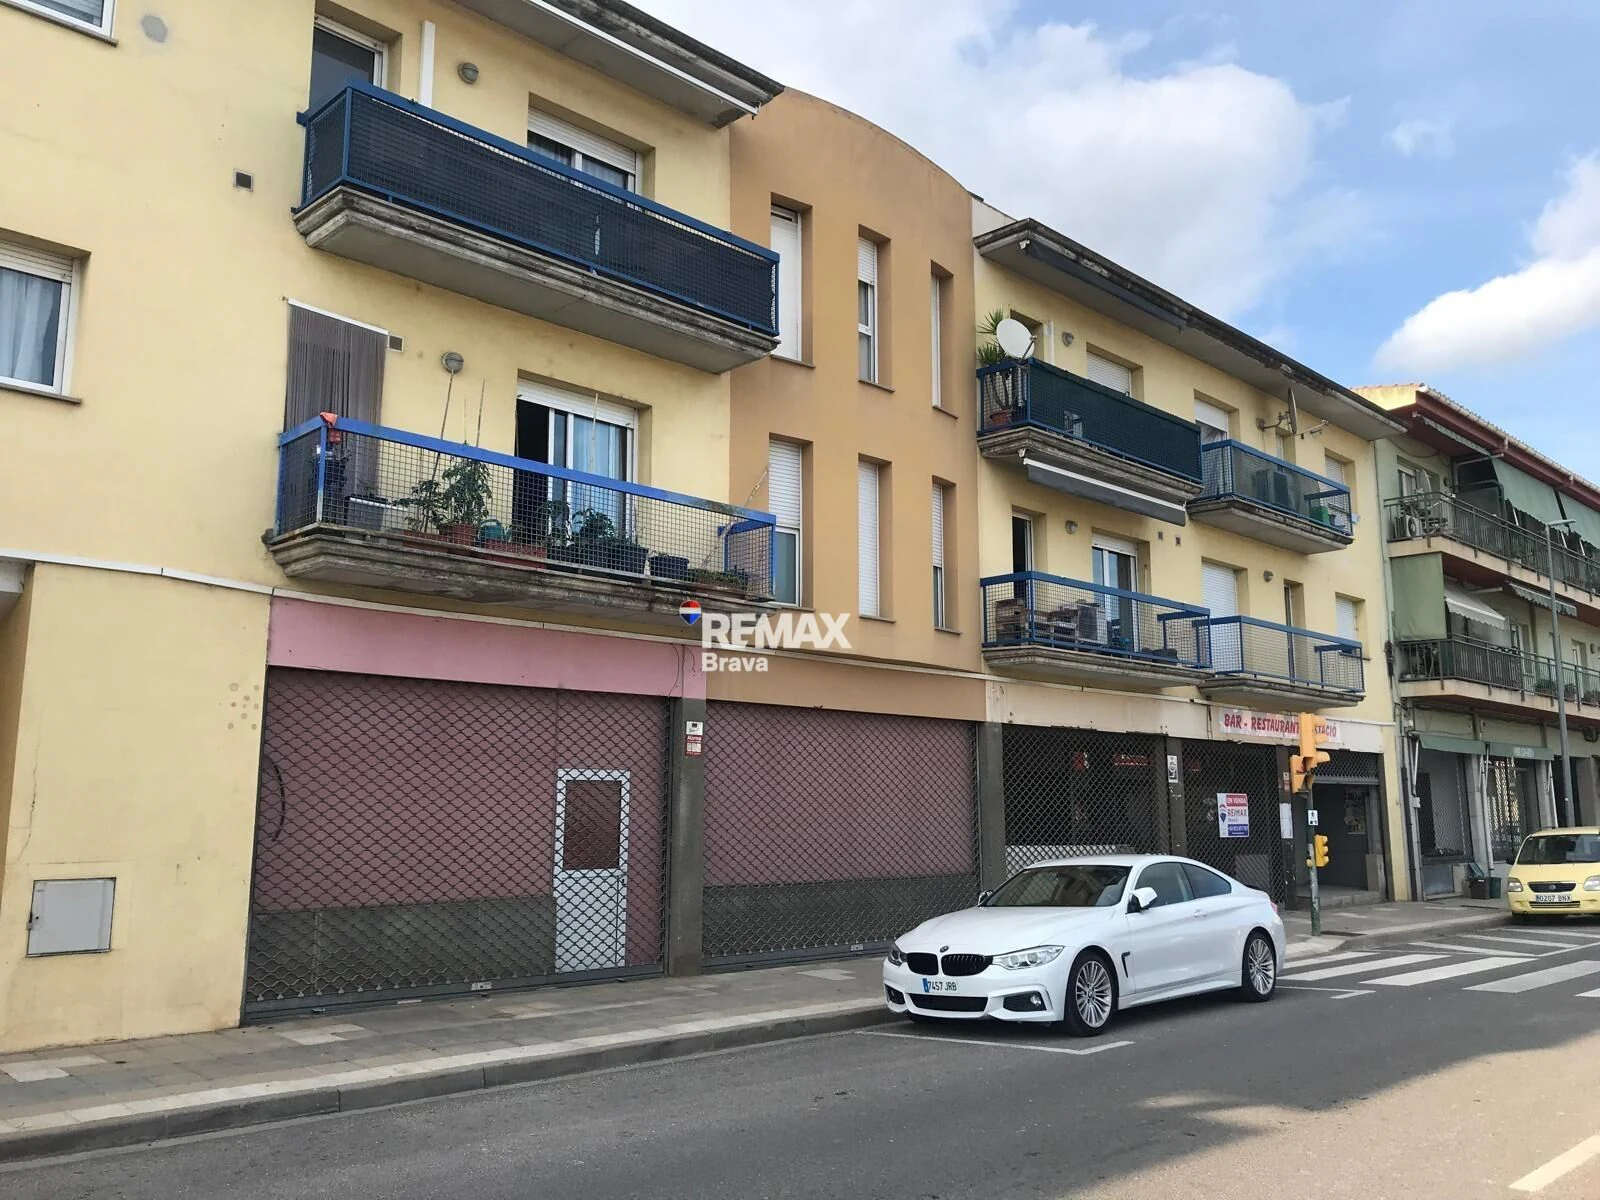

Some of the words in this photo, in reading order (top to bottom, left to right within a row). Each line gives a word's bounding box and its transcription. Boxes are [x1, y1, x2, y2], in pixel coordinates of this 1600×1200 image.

[1224, 713, 1242, 730] BAR
[1251, 716, 1299, 735] RESTAURANT
[1313, 722, 1337, 738] STACIÓ
[928, 981, 943, 991] 7457
[945, 981, 957, 991] JRB
